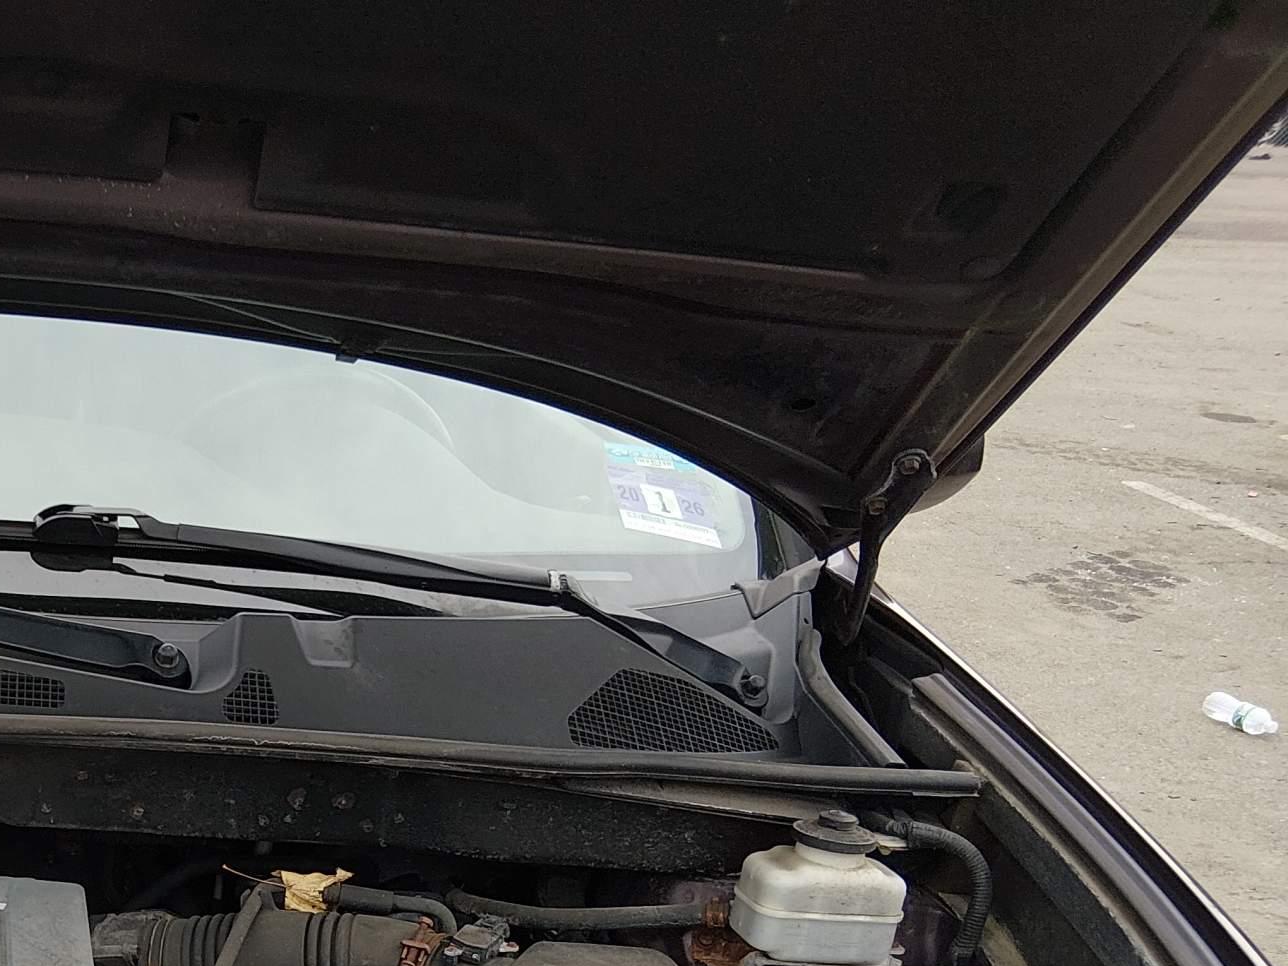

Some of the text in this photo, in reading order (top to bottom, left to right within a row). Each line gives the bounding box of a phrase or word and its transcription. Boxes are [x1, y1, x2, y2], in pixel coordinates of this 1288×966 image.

[617, 485, 705, 517] 20 1 26
